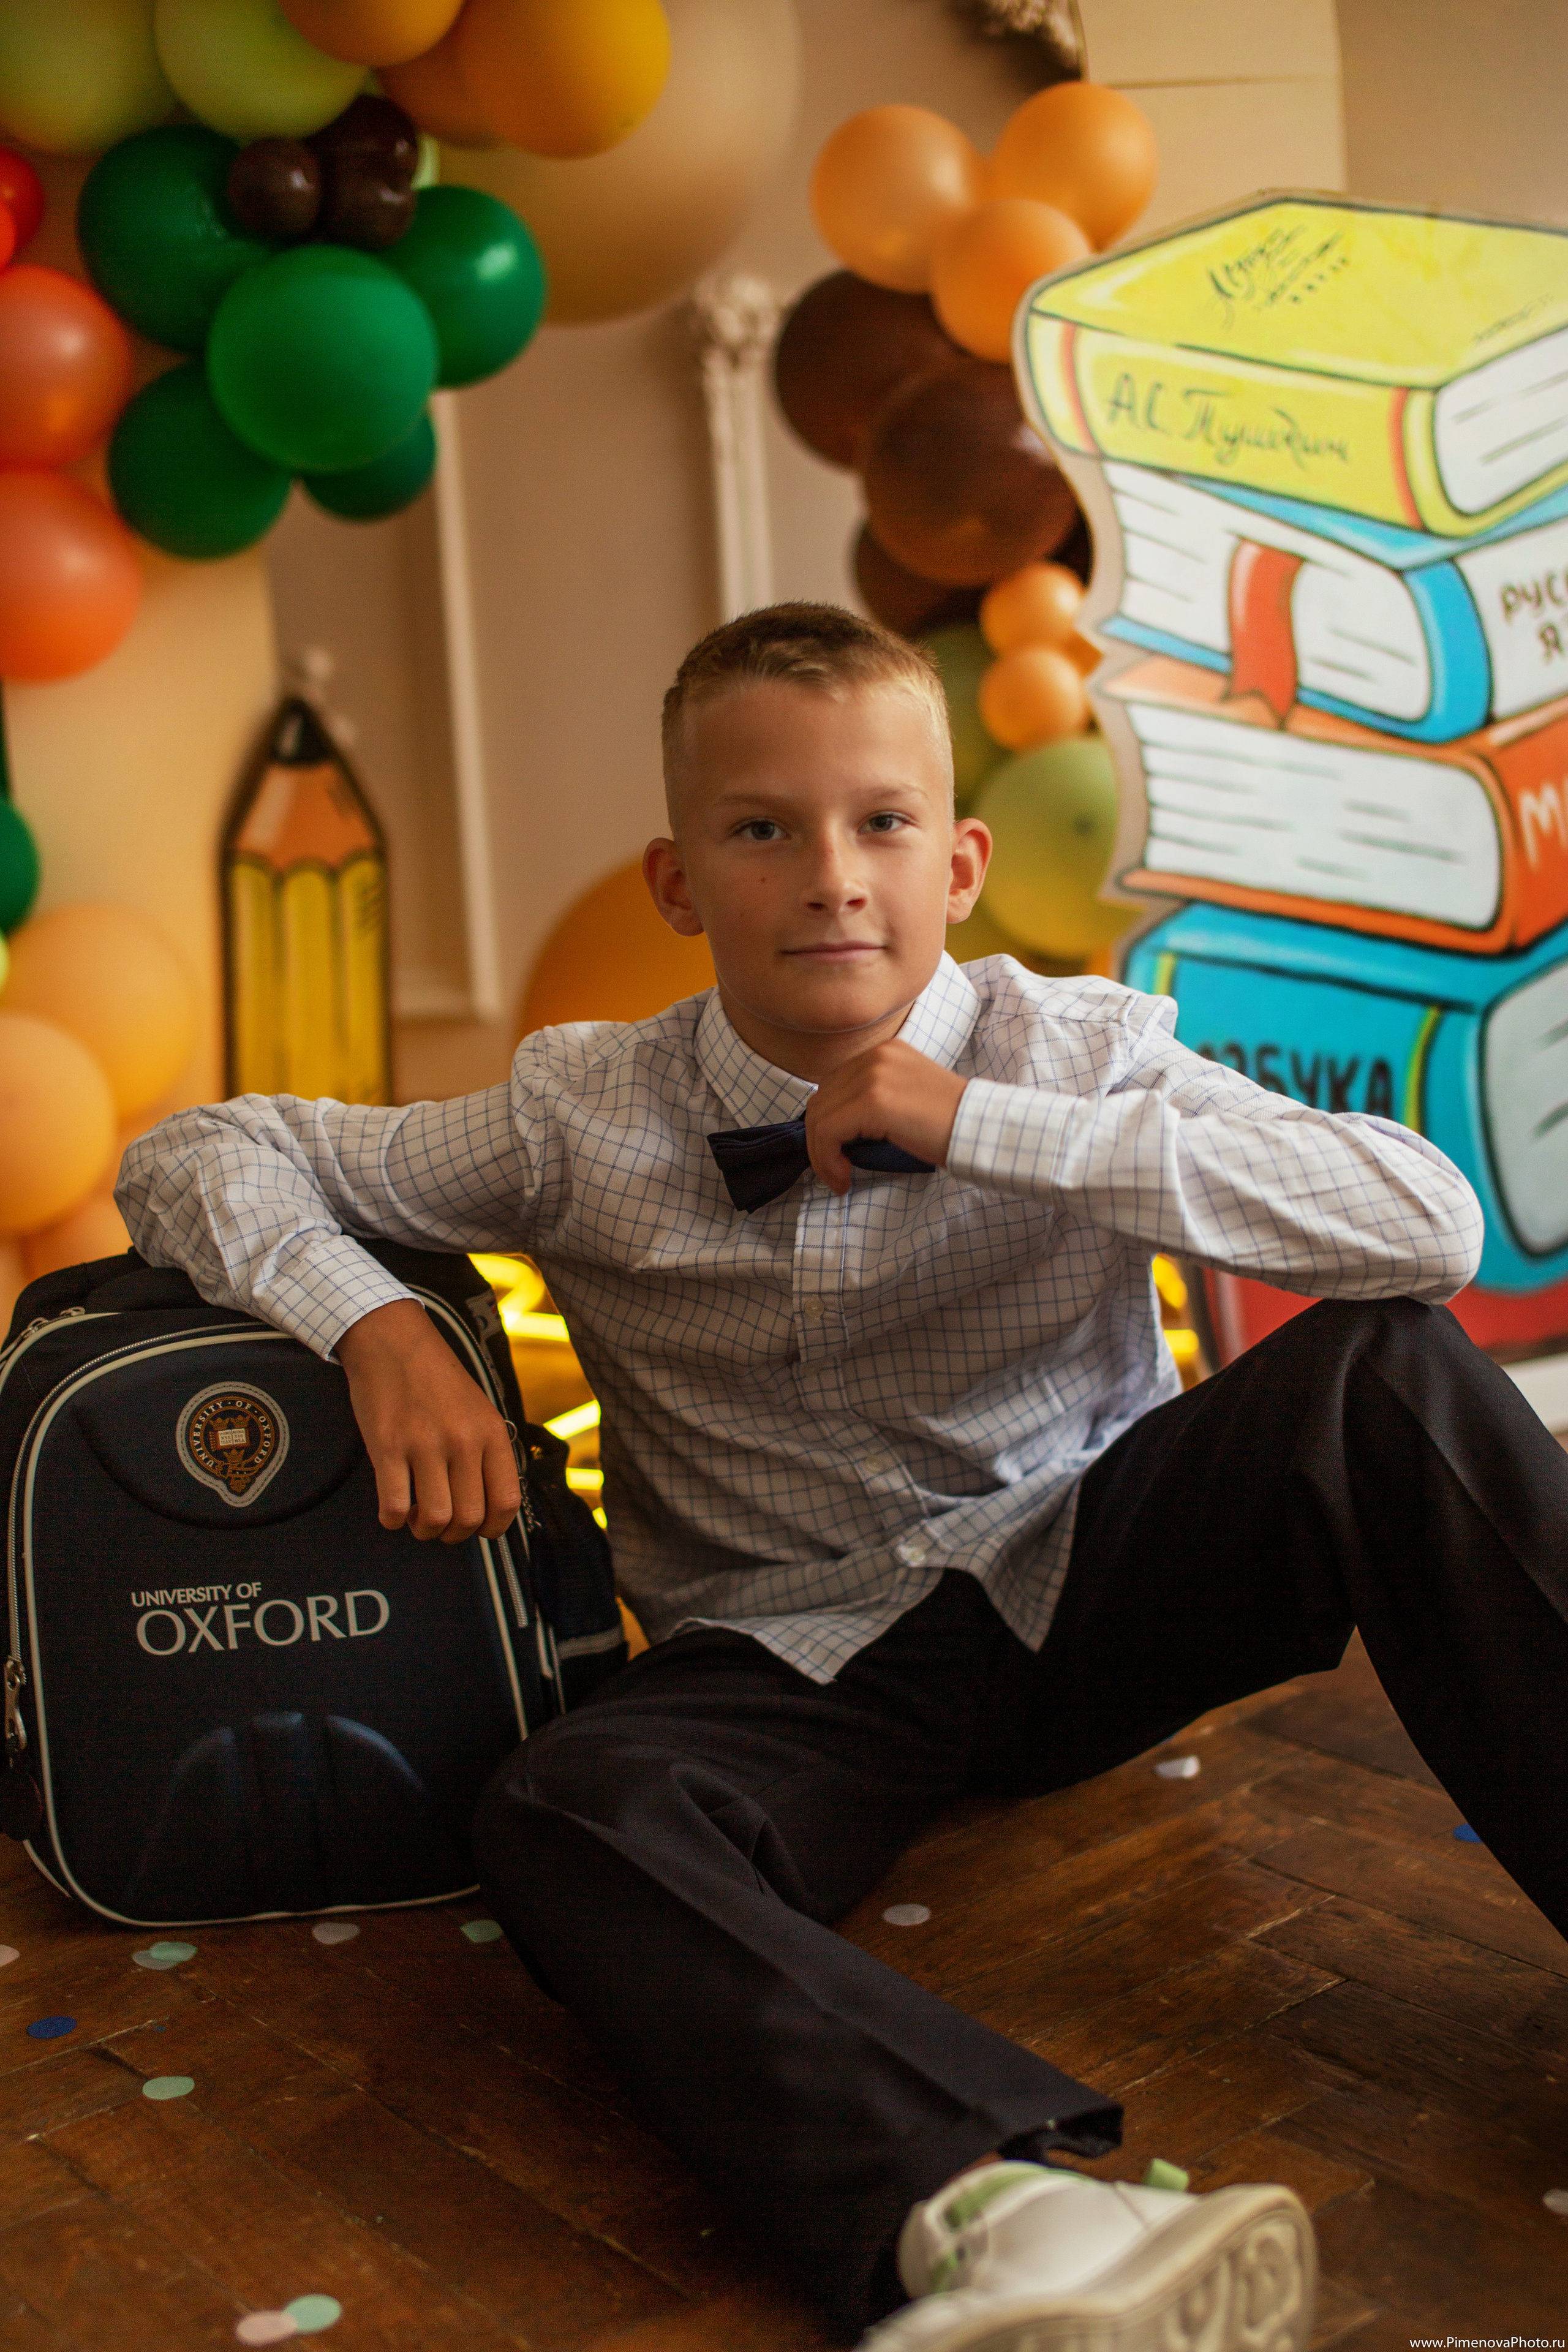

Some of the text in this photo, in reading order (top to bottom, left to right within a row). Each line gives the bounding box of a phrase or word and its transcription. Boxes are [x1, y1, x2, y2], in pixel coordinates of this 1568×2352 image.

[1501, 565, 1568, 627] РУС
[1519, 776, 1568, 870] М
[193, 1400, 271, 1468] UNIVERSITY OF OXFORD
[131, 1581, 262, 1608] UNIVERSITY OF
[136, 1589, 390, 1656] OXFORD
